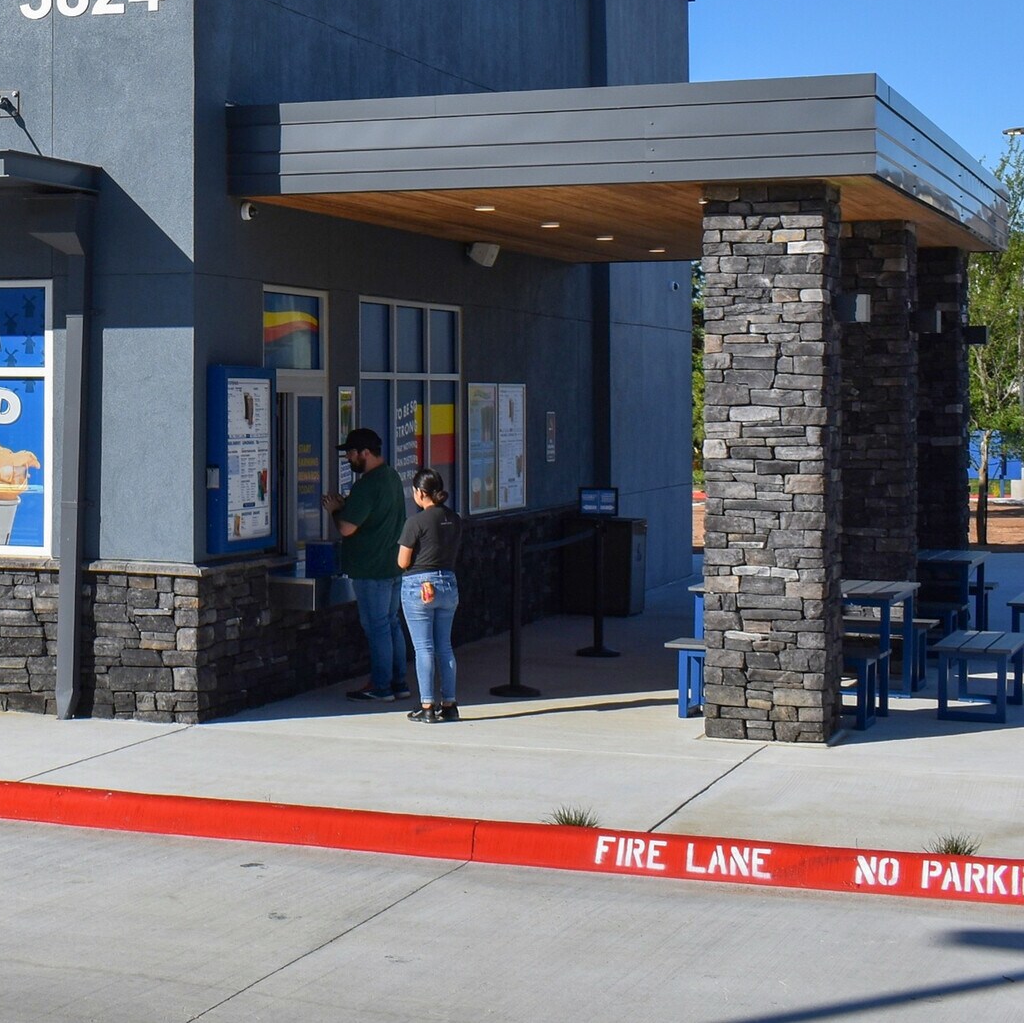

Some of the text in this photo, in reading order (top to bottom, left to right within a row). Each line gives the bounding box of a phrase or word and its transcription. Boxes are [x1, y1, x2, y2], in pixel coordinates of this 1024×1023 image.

[594, 835, 772, 880] FIRE LANE
[855, 855, 1024, 896] NO PARKI
